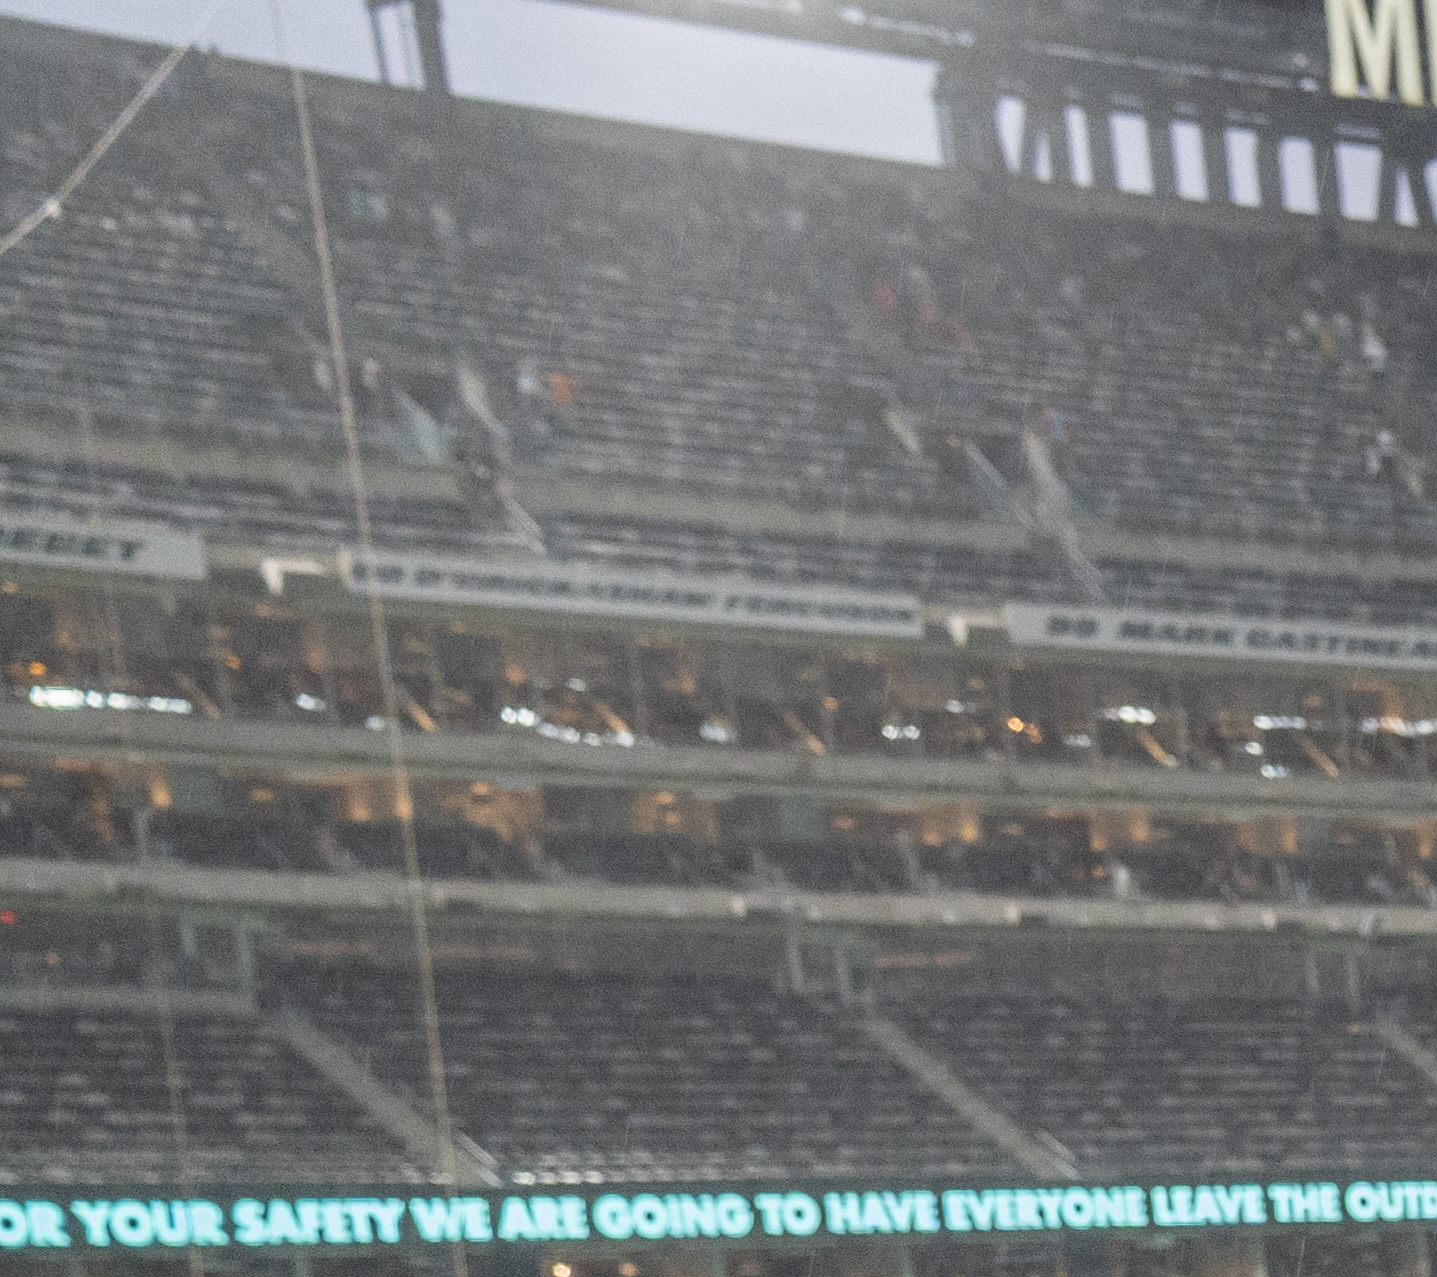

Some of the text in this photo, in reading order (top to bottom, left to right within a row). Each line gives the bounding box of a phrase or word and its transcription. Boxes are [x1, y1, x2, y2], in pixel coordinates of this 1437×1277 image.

[0, 1199, 70, 1249] OR
[71, 1199, 230, 1248] YOUR
[233, 1197, 404, 1247] SAFETY
[410, 1196, 493, 1243] WE
[498, 1195, 590, 1242] ARE
[593, 1193, 754, 1240] GOING
[755, 1192, 822, 1237] TO
[824, 1190, 941, 1235] HAVE
[943, 1186, 1149, 1232] EVERYONE
[1151, 1184, 1267, 1227] LEAVE
[1269, 1182, 1343, 1224] THE
